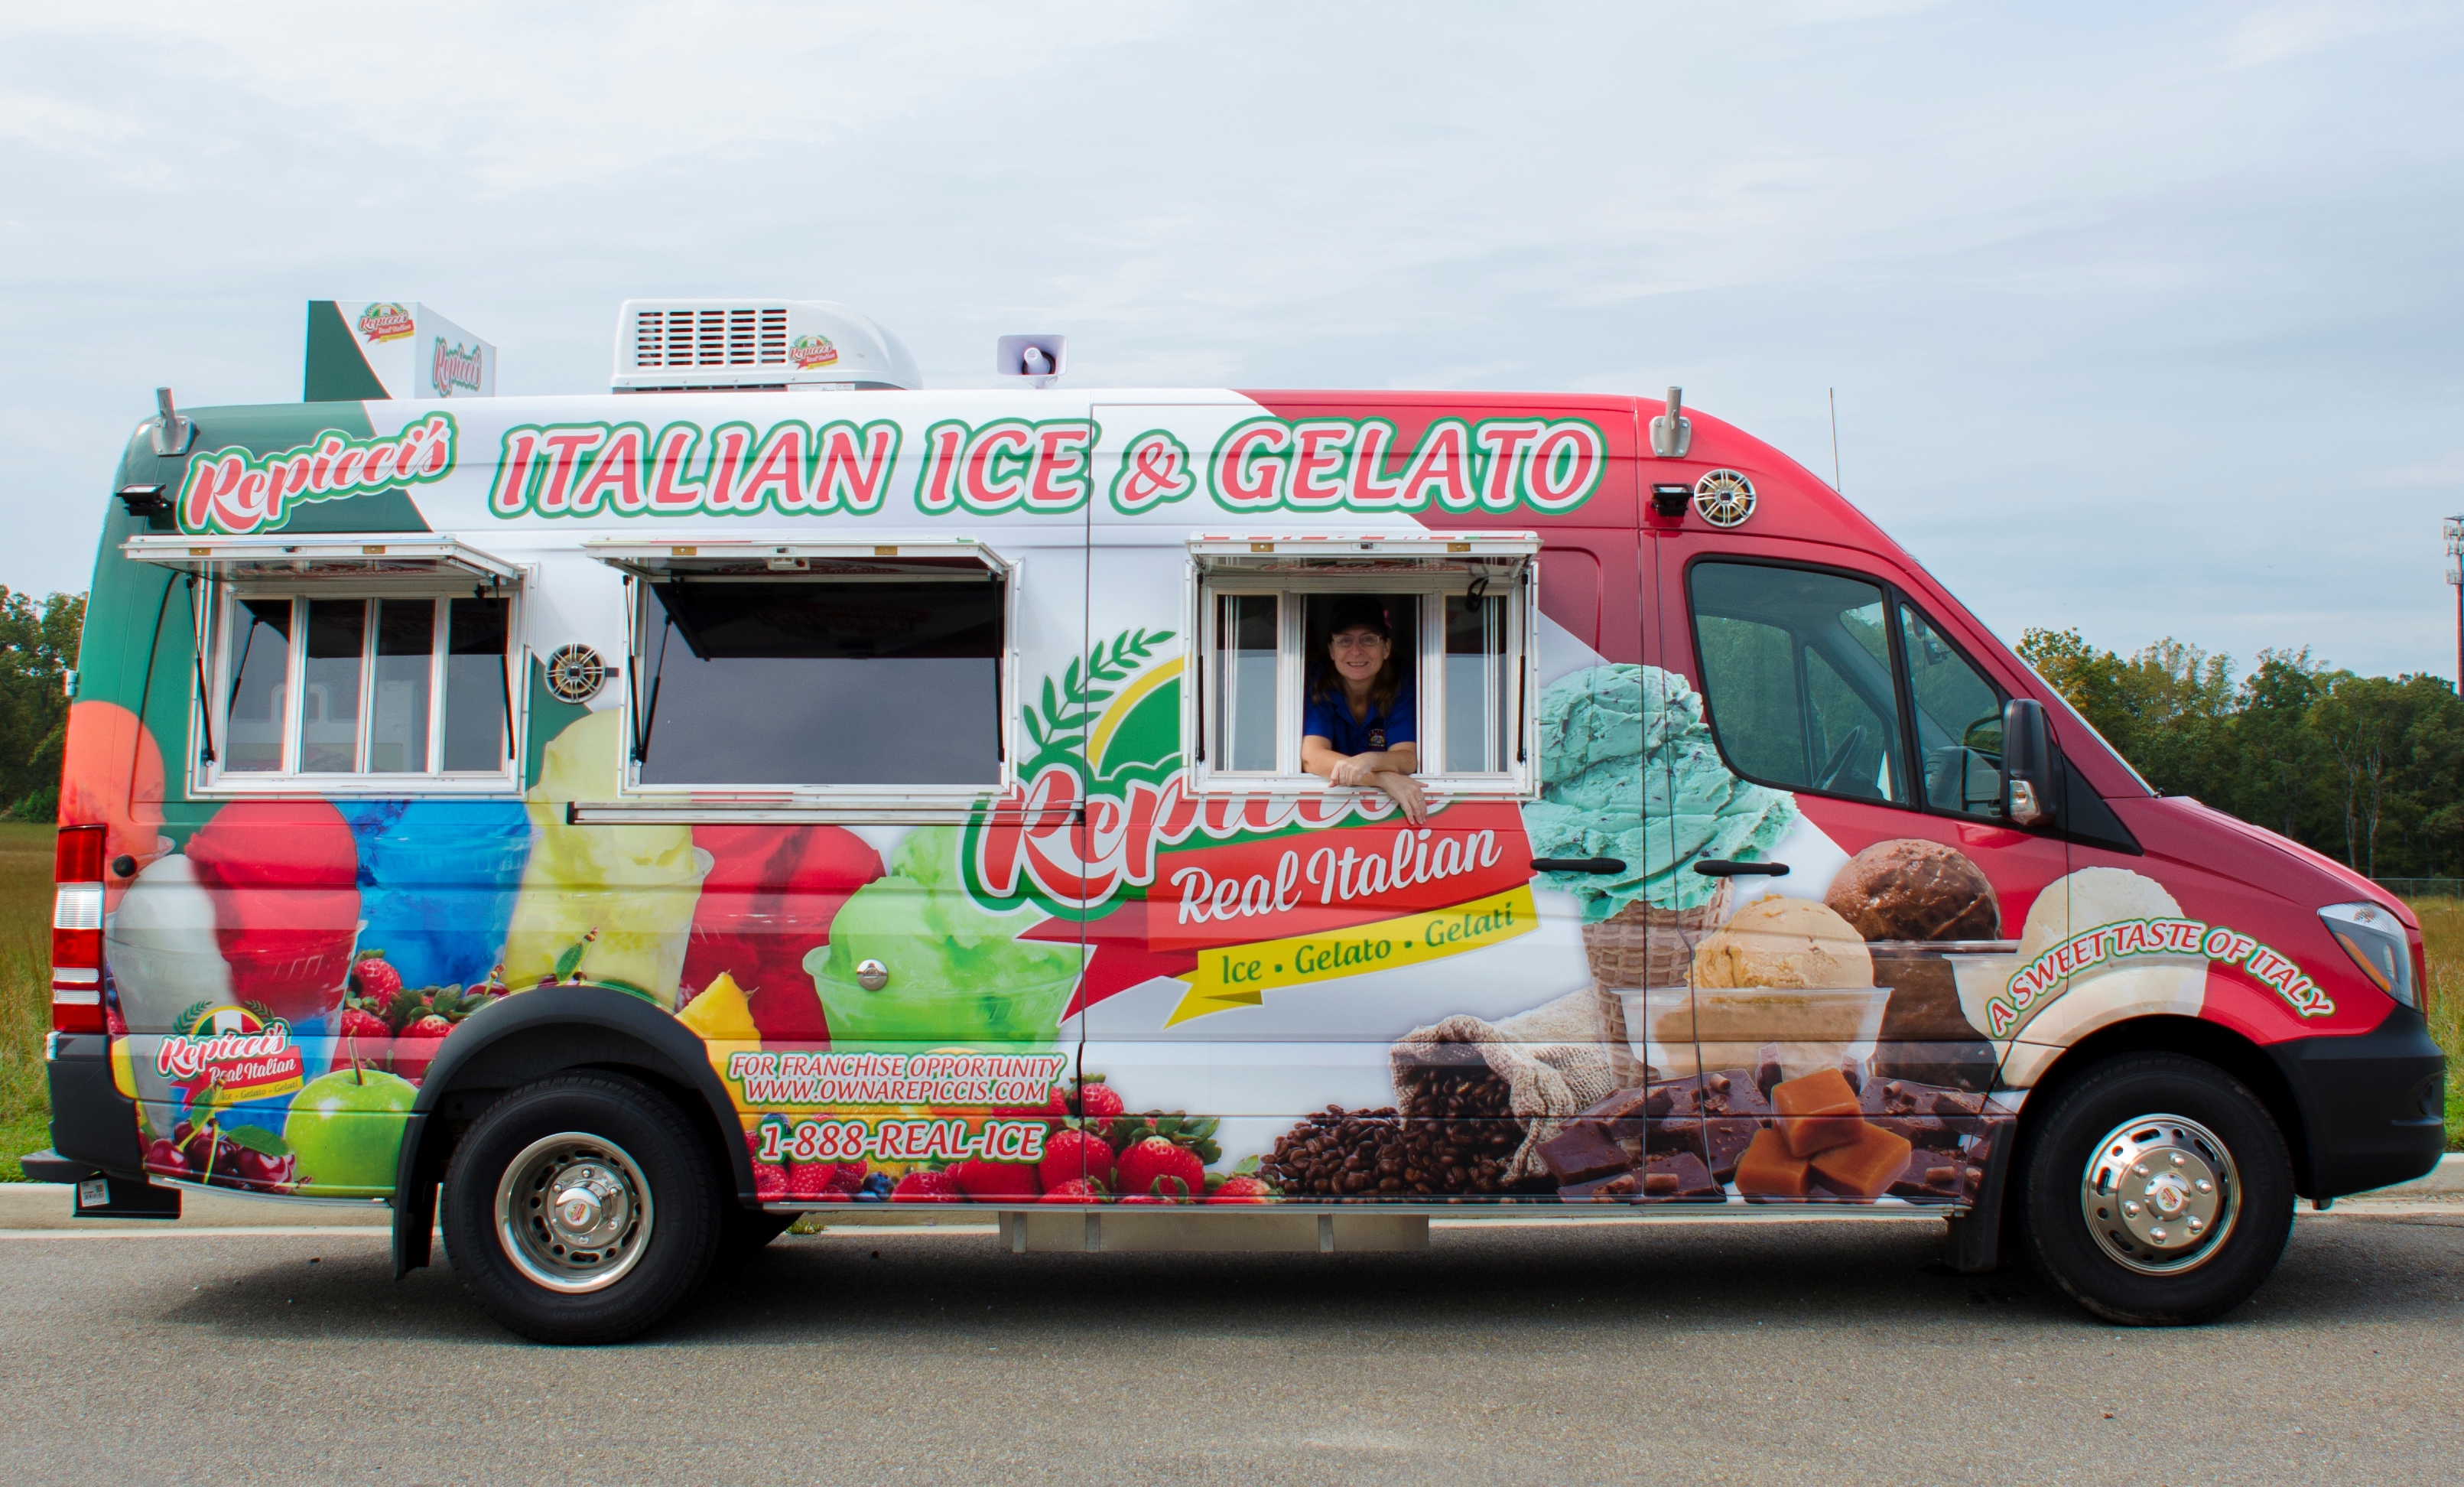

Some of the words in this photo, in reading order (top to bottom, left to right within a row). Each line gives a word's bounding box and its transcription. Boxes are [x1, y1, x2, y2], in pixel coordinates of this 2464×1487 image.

[187, 418, 448, 532] Repicci's
[501, 430, 891, 507] ITALIAN
[927, 428, 1089, 504] ICE
[1122, 440, 1182, 503] &
[1219, 427, 1595, 503] GELATO
[1170, 849, 1302, 925] Real
[1305, 828, 1503, 905] Italian
[1221, 955, 1263, 984] Ice
[1294, 937, 1392, 975] Gelato
[1424, 901, 1515, 949] Gelati
[1991, 1001, 2014, 1033] A
[2011, 930, 2107, 1007] SWEET
[2111, 922, 2202, 952] TASTE
[2206, 931, 2253, 960] OF
[2248, 949, 2332, 1014] ITALY
[160, 1023, 285, 1078] Repicci's
[244, 1058, 297, 1080] Italian
[731, 1055, 776, 1077] FOR
[780, 1056, 903, 1078] FRANCHISE
[909, 1056, 1062, 1079] OPPORTUNITY
[240, 1088, 267, 1098] Gelato
[274, 1079, 299, 1092] Gelati
[747, 1079, 1047, 1101] WWW.OWNAREPICCIS.COM
[762, 1123, 1045, 1158] 1-888-REAL-ICE
